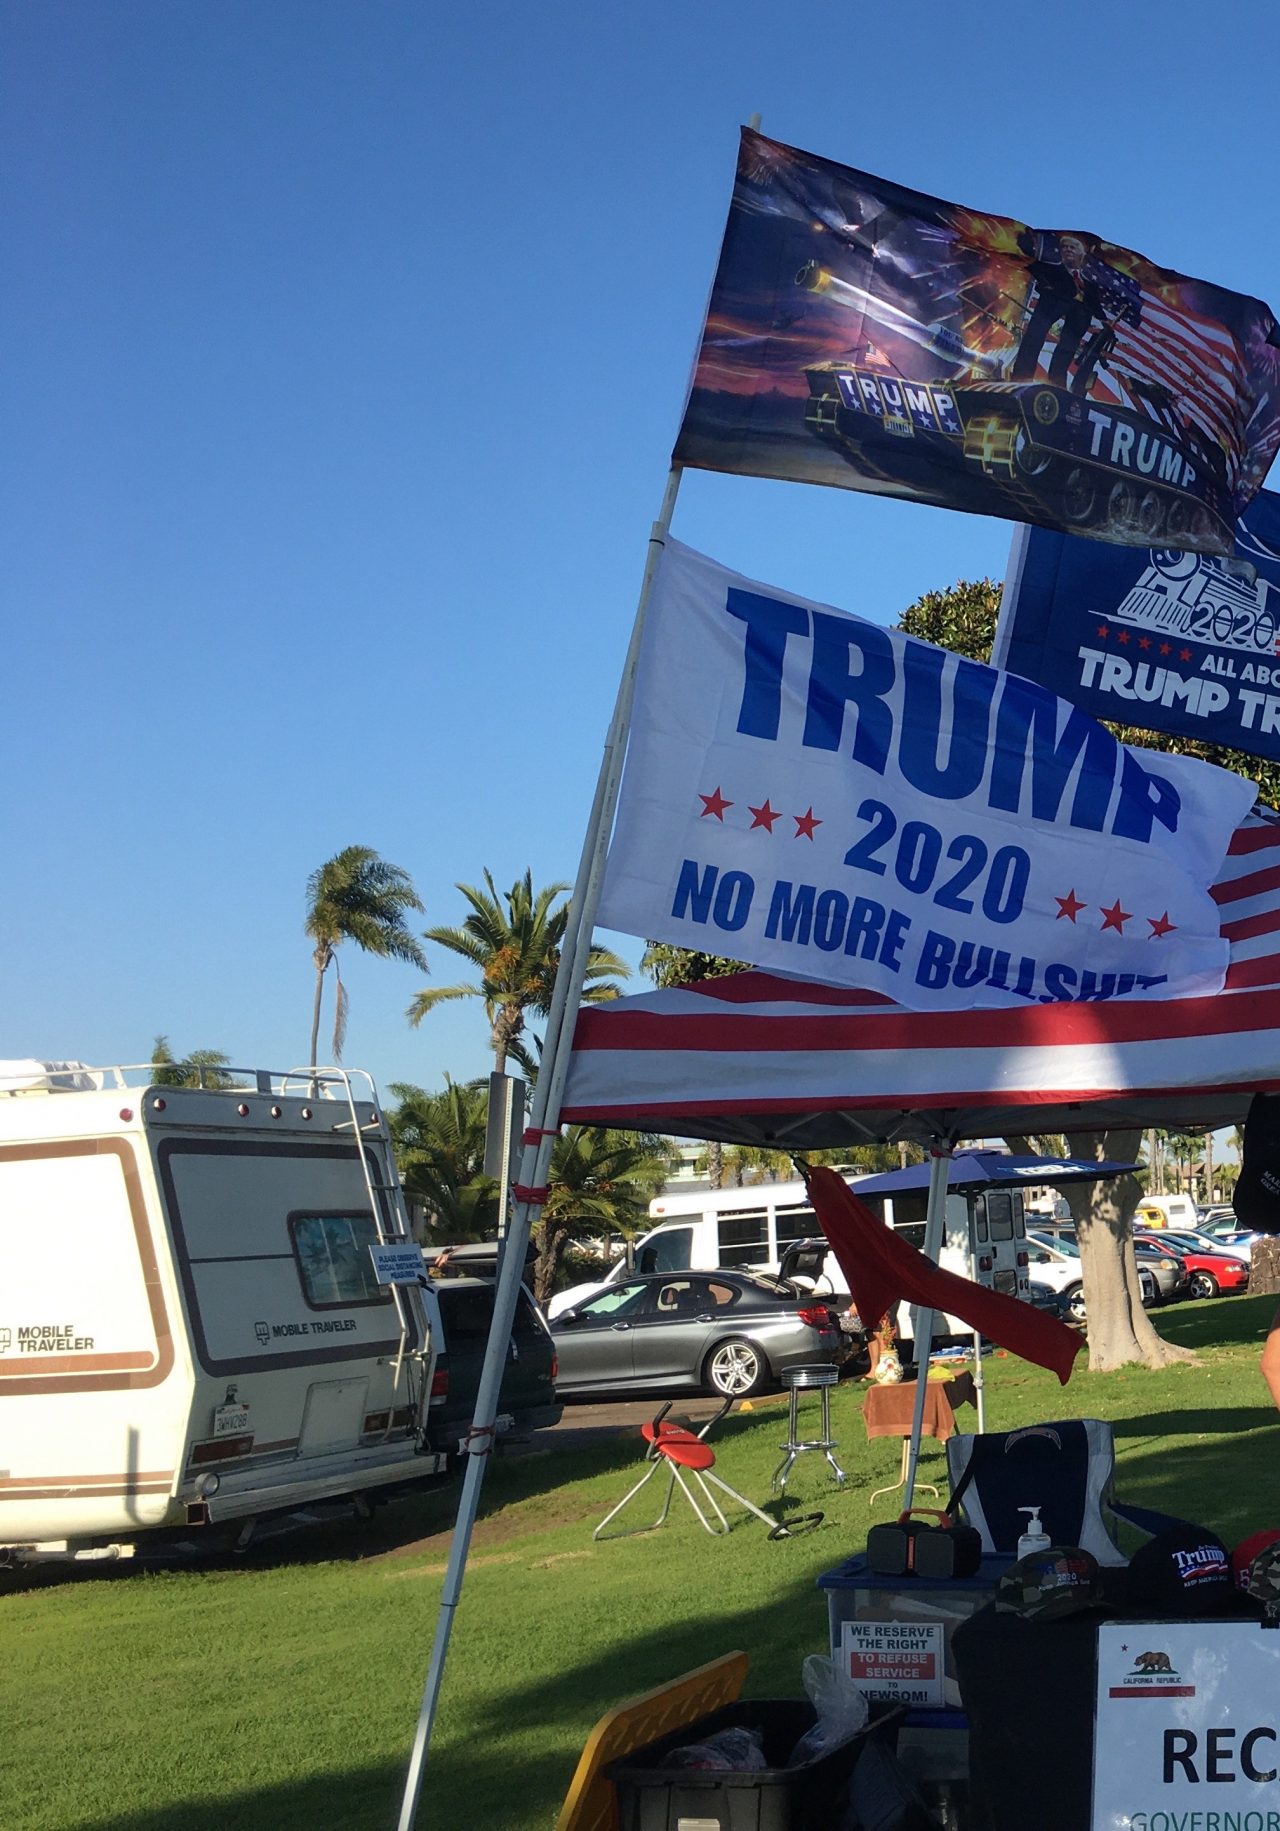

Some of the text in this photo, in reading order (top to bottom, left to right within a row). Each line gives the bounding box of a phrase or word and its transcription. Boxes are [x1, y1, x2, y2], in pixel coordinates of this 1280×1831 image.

[839, 375, 954, 416] TRUMP
[1087, 409, 1196, 488] TRUMP
[1190, 601, 1276, 650] 2020
[1200, 654, 1237, 679] ALL
[1078, 646, 1230, 718] TRUMP
[726, 587, 1181, 843] TRUMP
[844, 799, 1031, 924] 2020
[671, 860, 755, 932] NO
[764, 881, 912, 974] MORE
[18, 1325, 74, 1339] MOBILE
[272, 1319, 358, 1337] MOBILE TRAVELER
[18, 1337, 95, 1352] TRAVELER
[1172, 1549, 1225, 1568] Trump
[851, 1626, 934, 1637] WE RESERVE
[857, 1639, 928, 1650] THE RIGHT
[858, 1653, 928, 1664] TO REFUSE
[866, 1667, 920, 1678] SERVICE
[859, 1690, 929, 1702] NEWSOM!
[1130, 1811, 1280, 1831] GOVERNOR
